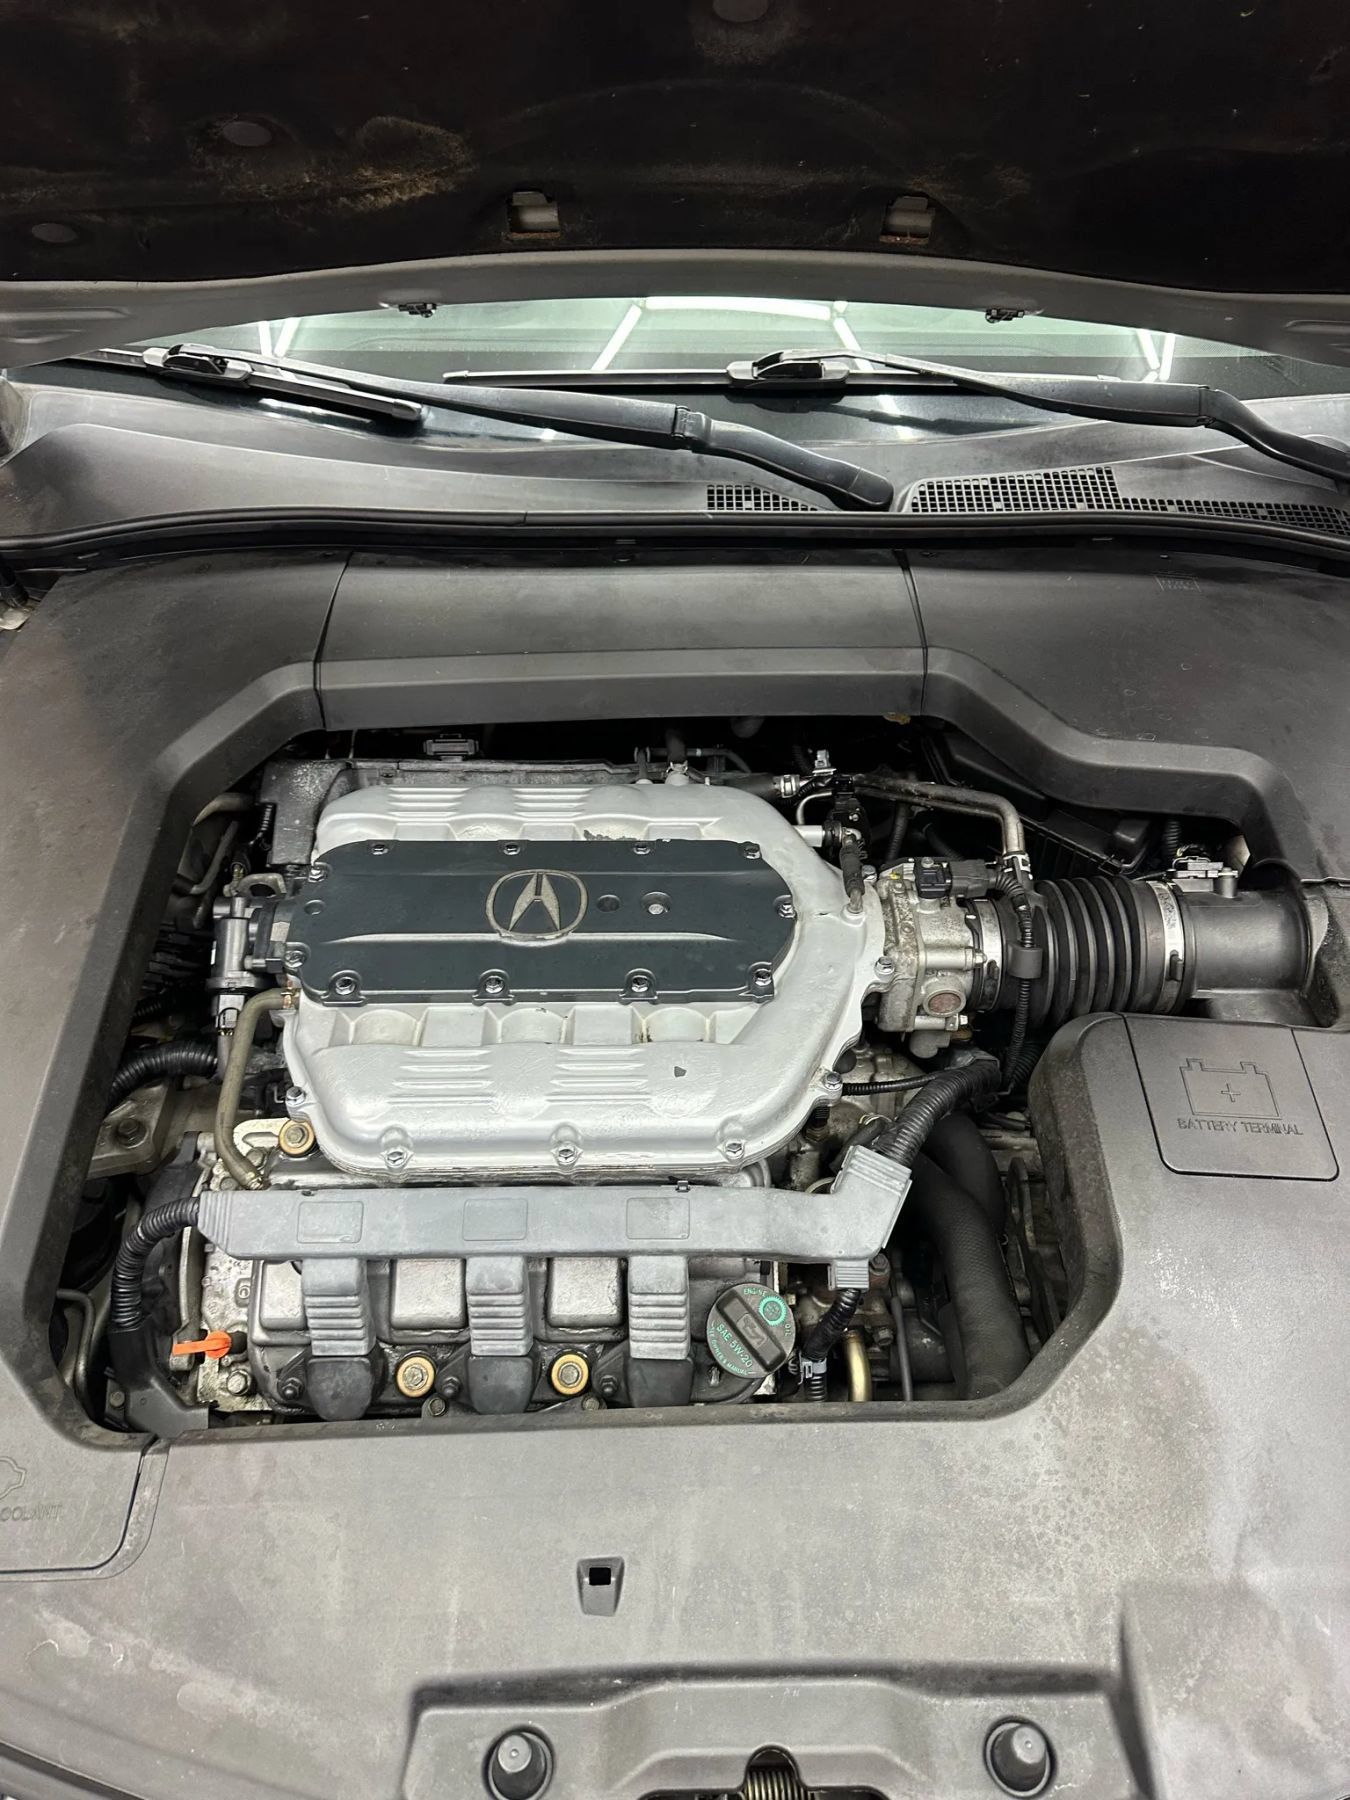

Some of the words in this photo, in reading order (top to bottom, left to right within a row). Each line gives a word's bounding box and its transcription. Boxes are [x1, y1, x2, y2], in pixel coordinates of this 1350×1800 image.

[1177, 1118, 1237, 1132] BATTERY
[1240, 1121, 1304, 1136] TERMINAL
[743, 1287, 767, 1297] ENGINE
[716, 1323, 733, 1342] SAE
[726, 1361, 748, 1376] MANUAL
